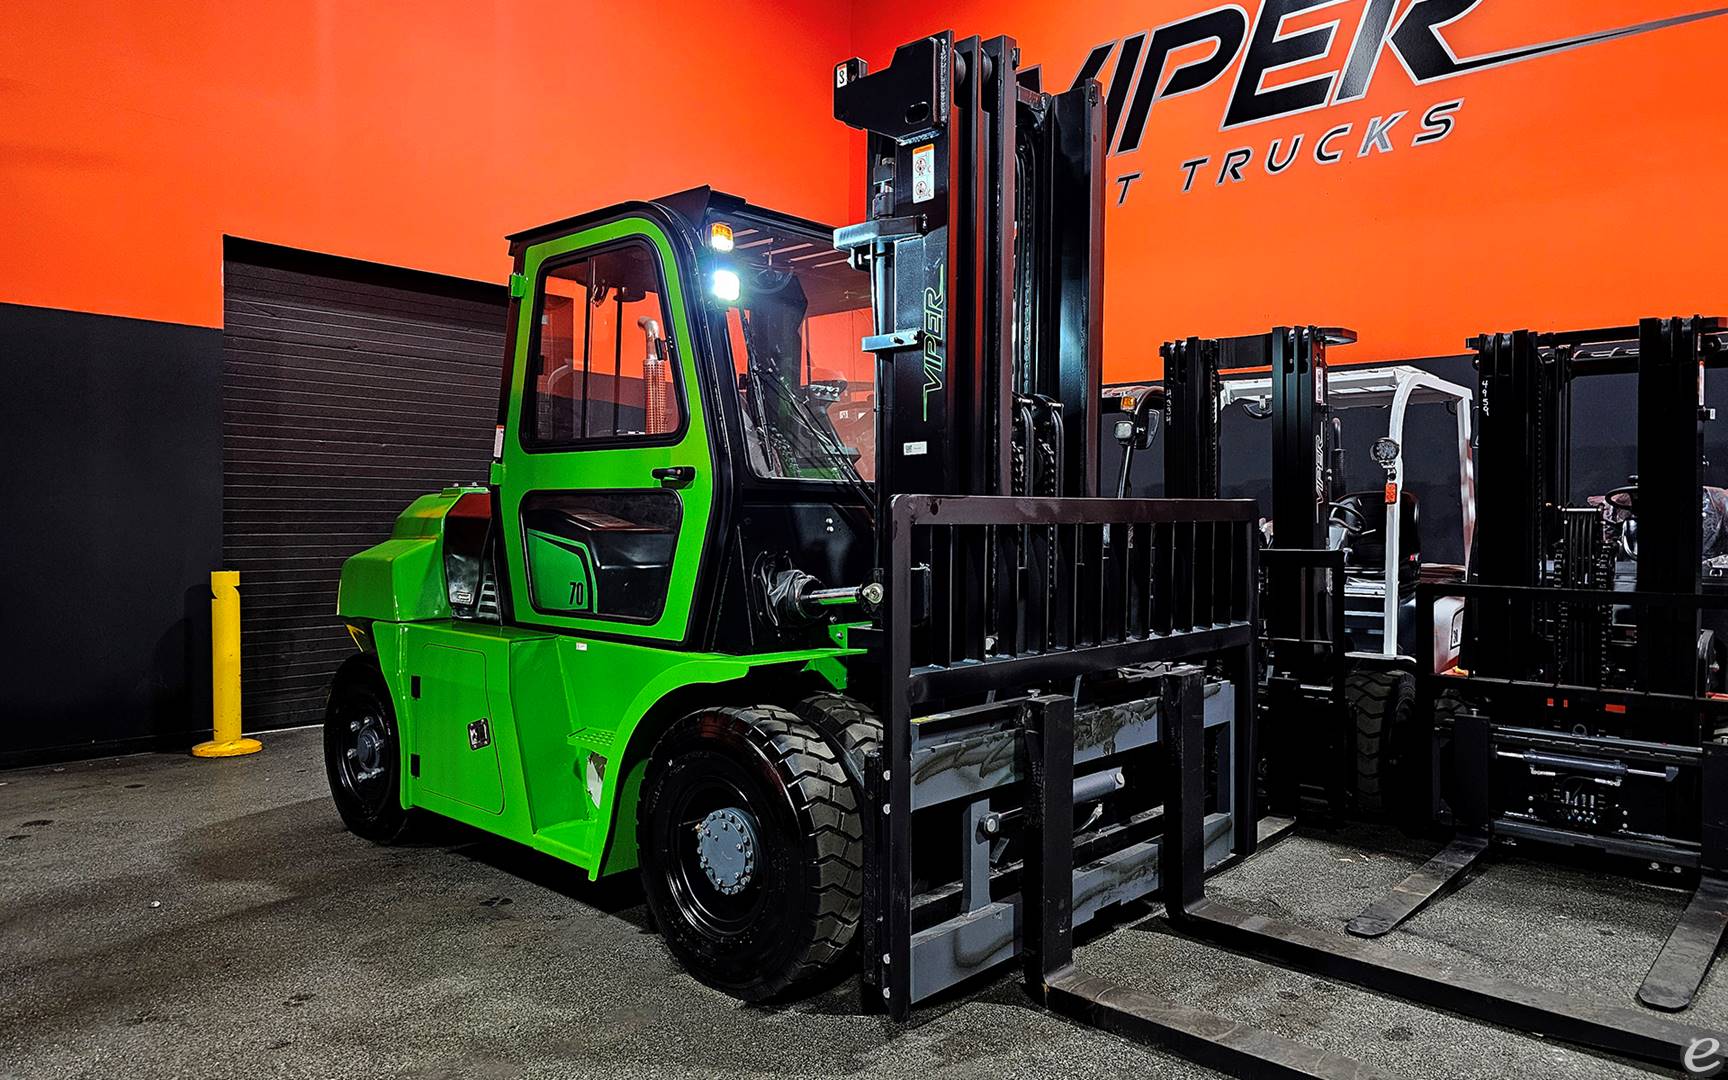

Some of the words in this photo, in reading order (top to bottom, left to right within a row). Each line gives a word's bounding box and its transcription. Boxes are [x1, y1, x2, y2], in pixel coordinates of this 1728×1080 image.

[1180, 97, 1465, 193] TRUCKS
[922, 274, 944, 411] VIPER
[1481, 379, 1489, 417] 4959
[1315, 428, 1325, 512] VIPER
[569, 581, 584, 606] 70
